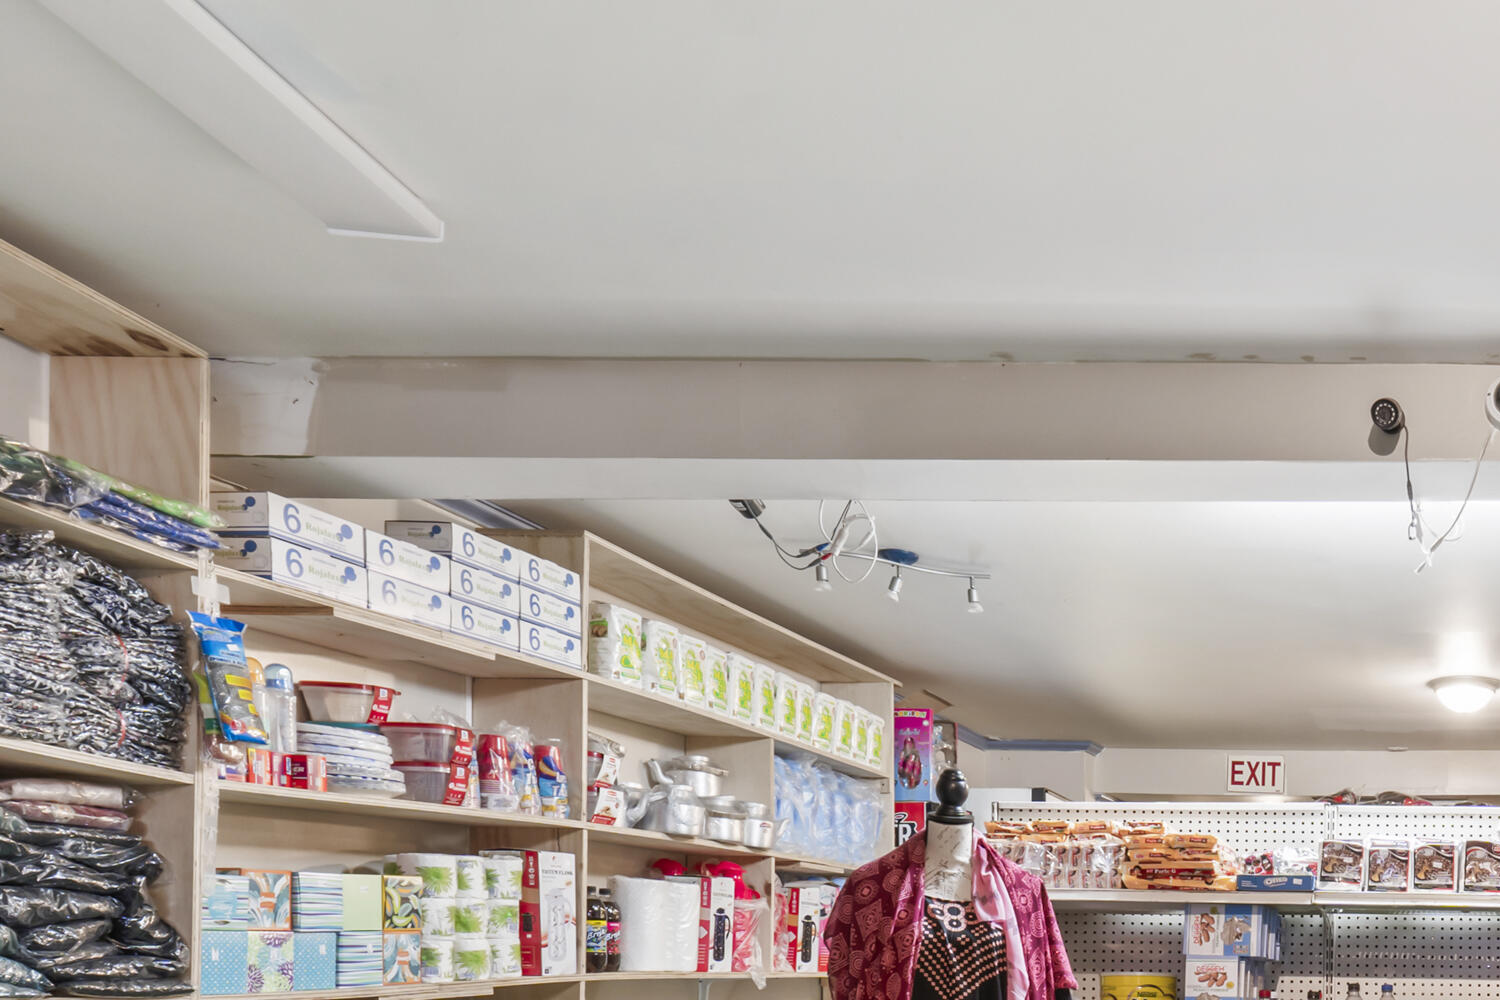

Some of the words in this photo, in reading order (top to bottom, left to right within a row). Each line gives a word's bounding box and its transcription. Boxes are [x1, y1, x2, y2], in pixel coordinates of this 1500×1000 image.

[283, 503, 301, 534] 6
[379, 539, 395, 566] 6
[462, 532, 475, 557] 6
[286, 548, 304, 578] 6
[528, 558, 540, 582] 6
[382, 580, 397, 605] 6
[460, 569, 473, 594] 6
[461, 605, 475, 630] 6
[529, 593, 541, 617] 6
[529, 627, 541, 651] 6
[1230, 760, 1281, 787] EXIT
